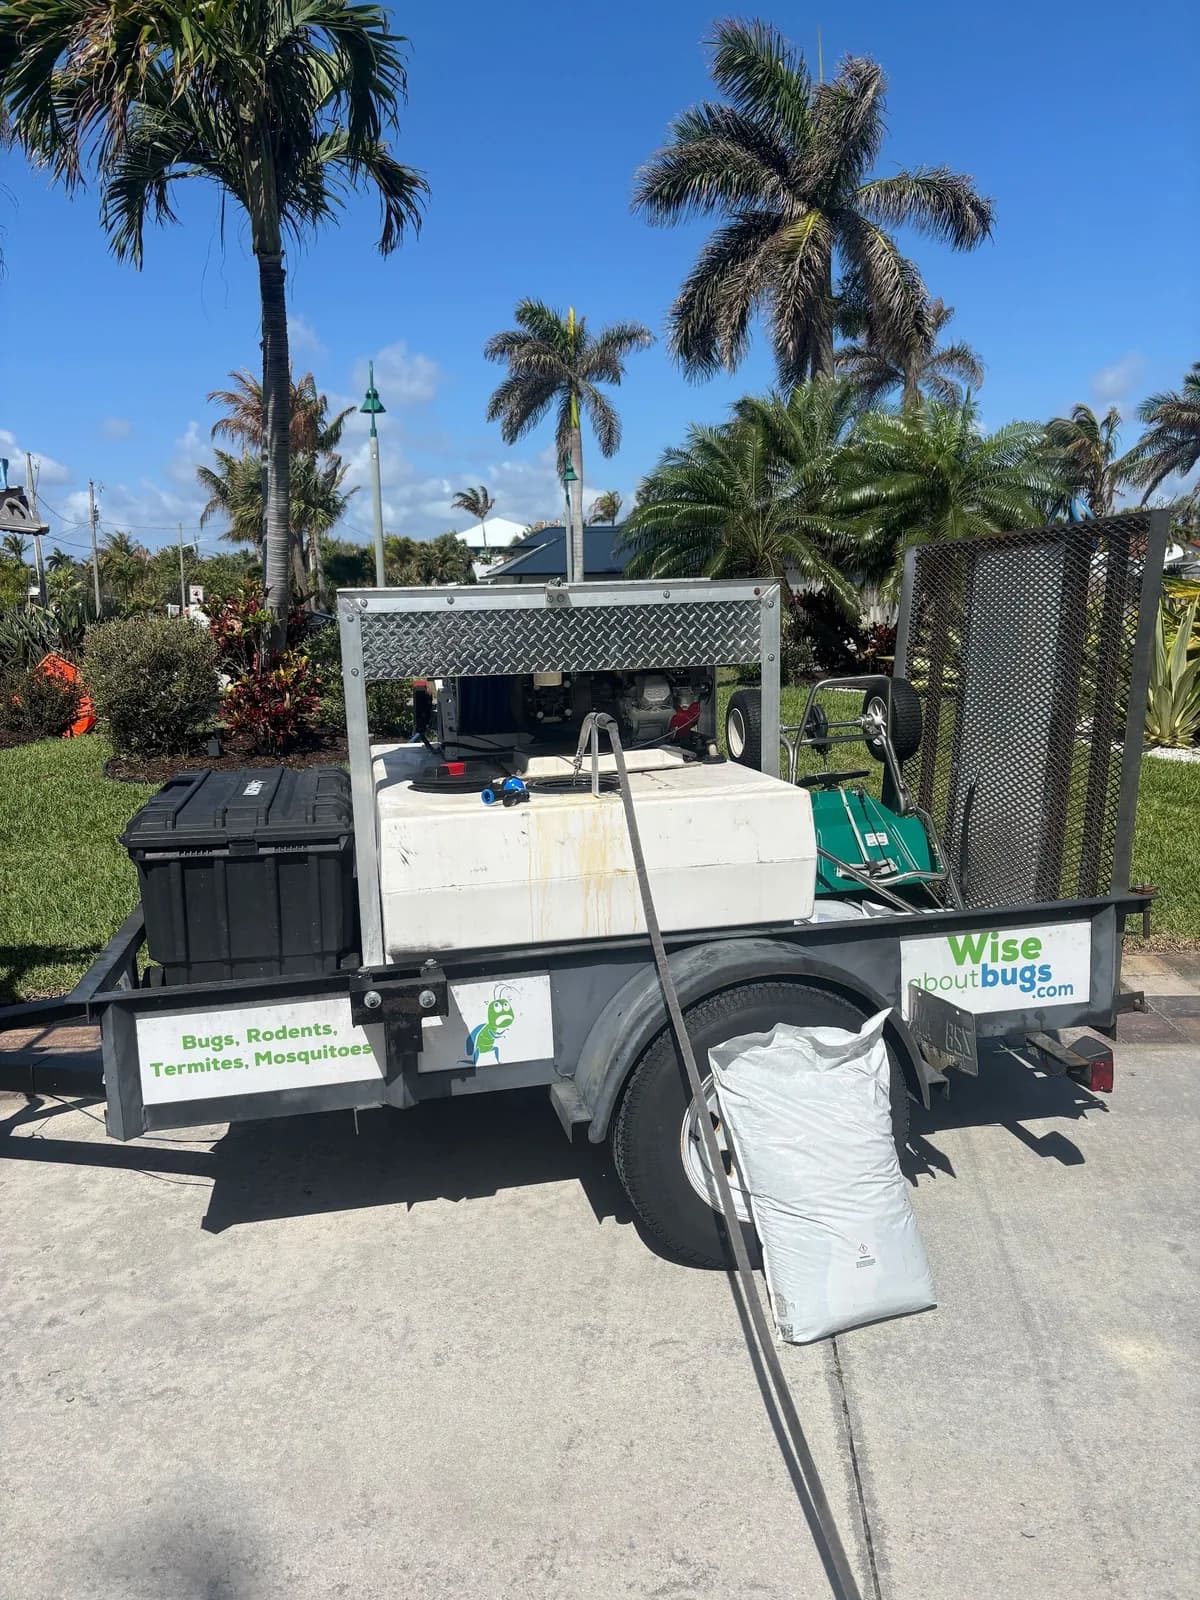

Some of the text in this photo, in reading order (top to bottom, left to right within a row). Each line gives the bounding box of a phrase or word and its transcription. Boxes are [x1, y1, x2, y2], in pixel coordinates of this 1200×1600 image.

[947, 931, 1042, 966] Wise
[181, 1022, 338, 1052] Bugs, Rodents,
[149, 1042, 374, 1078] Termites, Mosquitoes
